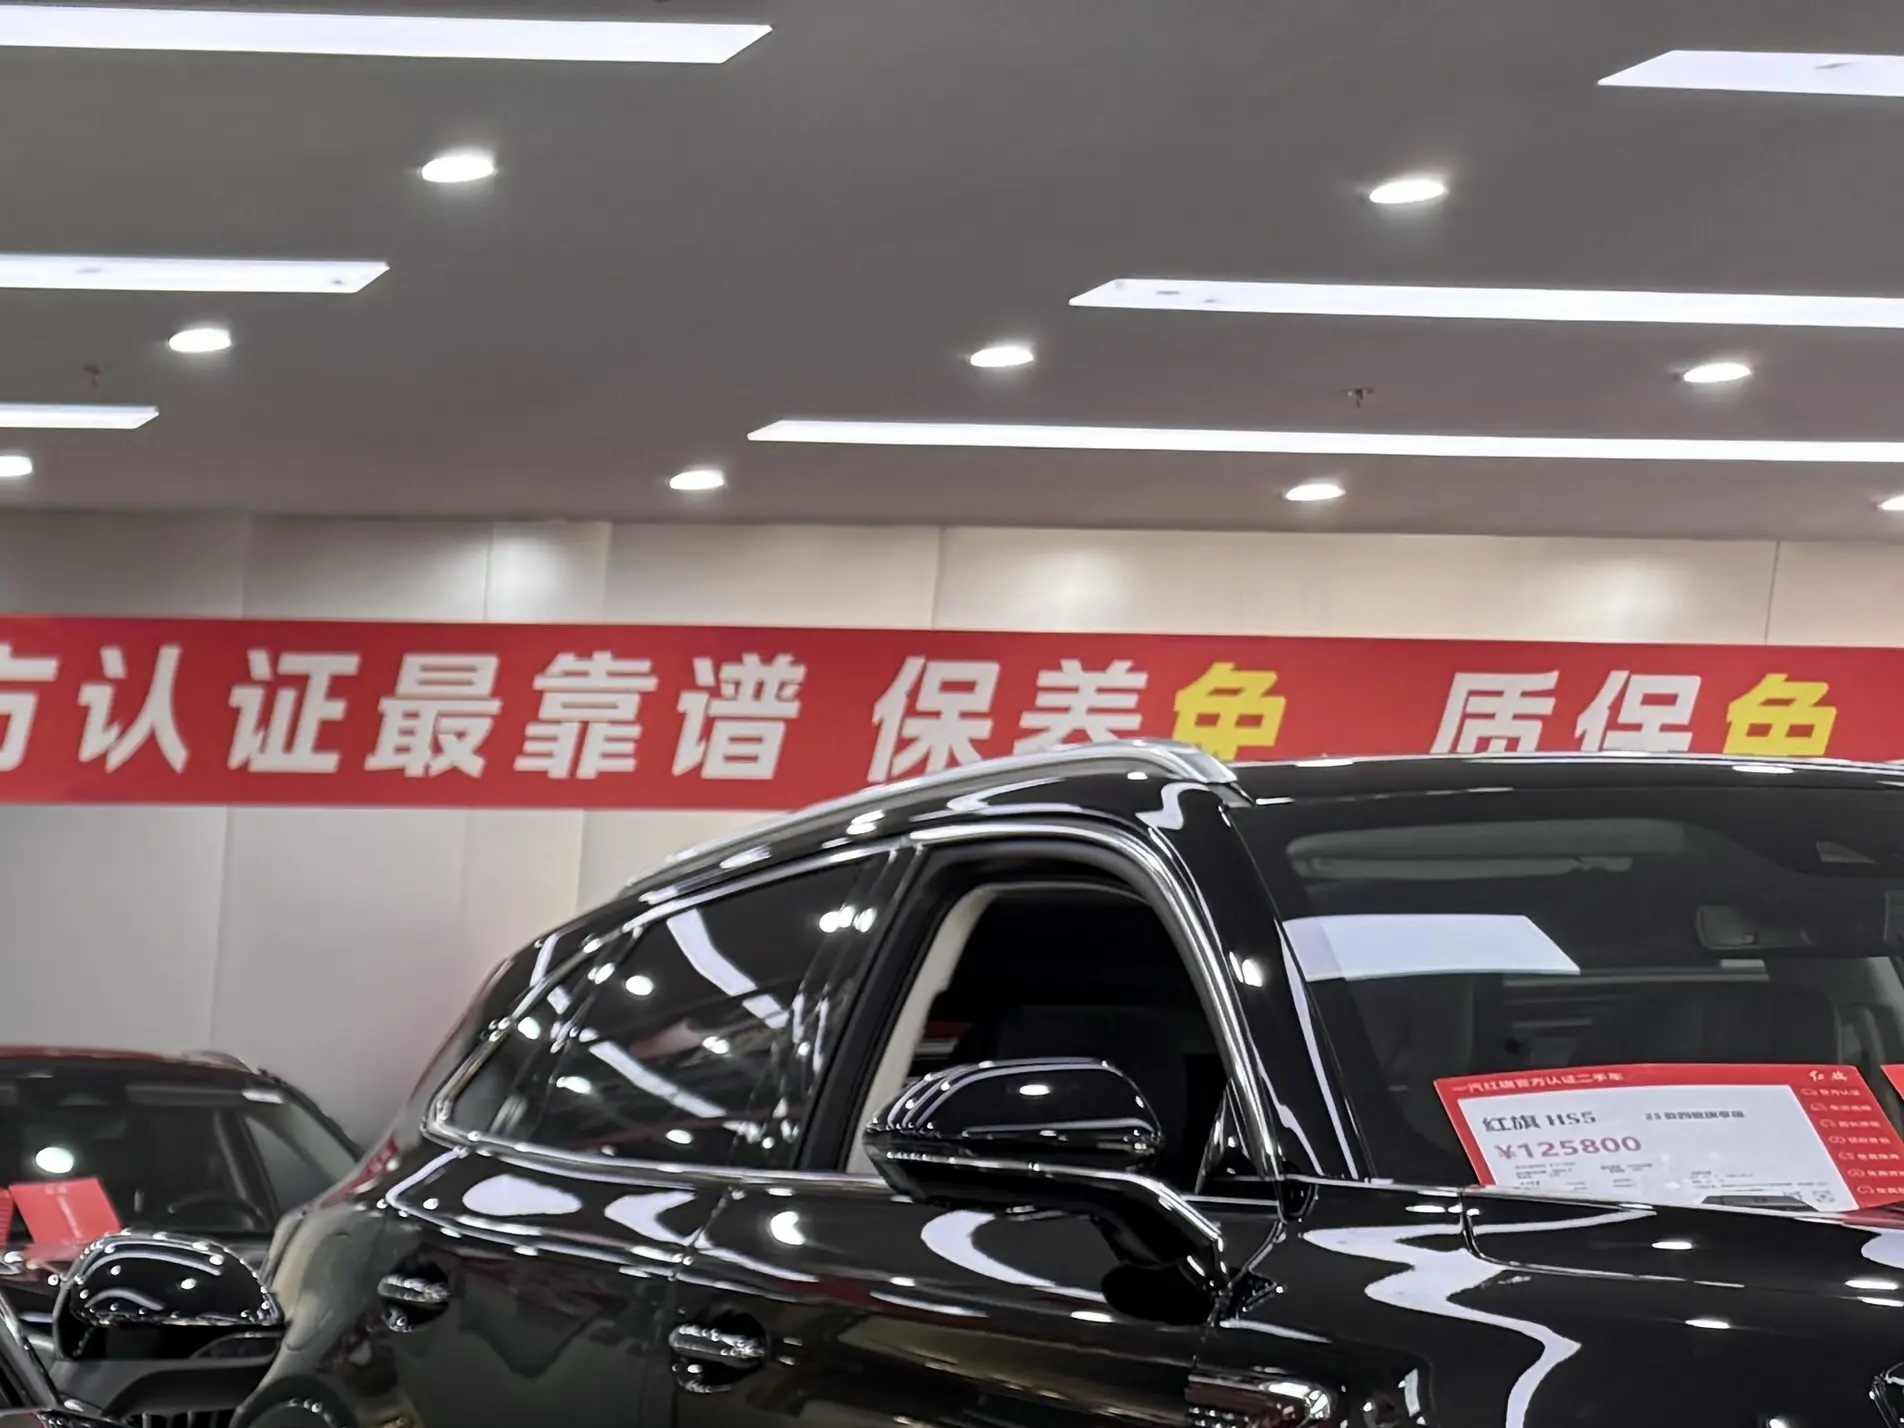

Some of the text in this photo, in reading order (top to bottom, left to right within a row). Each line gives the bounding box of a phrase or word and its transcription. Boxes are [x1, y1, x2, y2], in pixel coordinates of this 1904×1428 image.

[1481, 1110, 1597, 1132] 红旗 HS5
[1494, 1135, 1642, 1161] ¥125800
